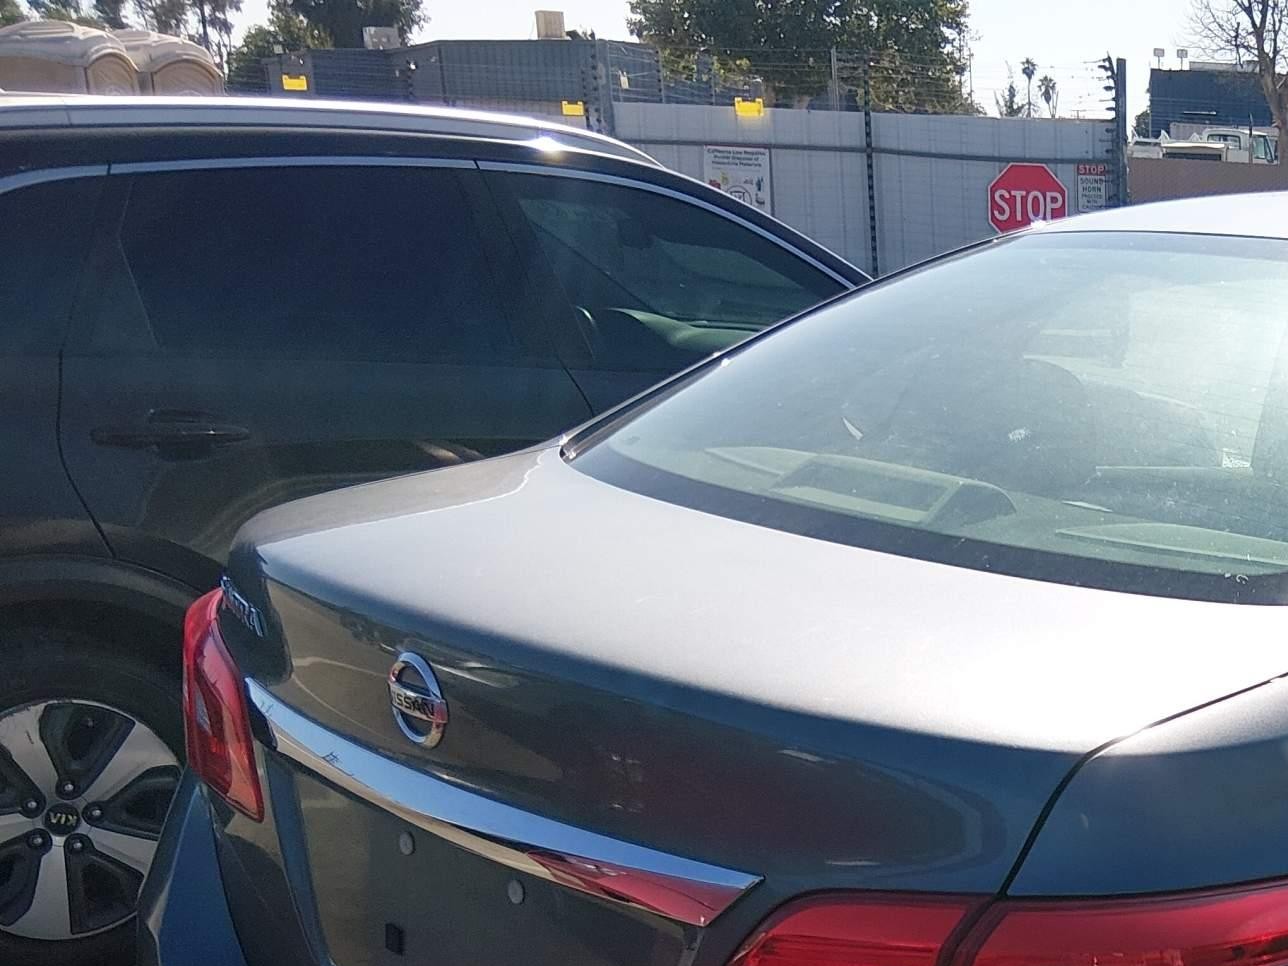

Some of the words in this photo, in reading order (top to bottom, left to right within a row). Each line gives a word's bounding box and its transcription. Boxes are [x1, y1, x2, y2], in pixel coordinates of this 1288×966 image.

[1079, 165, 1105, 174] STOP
[993, 189, 1063, 222] STOP
[392, 689, 435, 717] ISSAN
[49, 812, 78, 827] KIA
